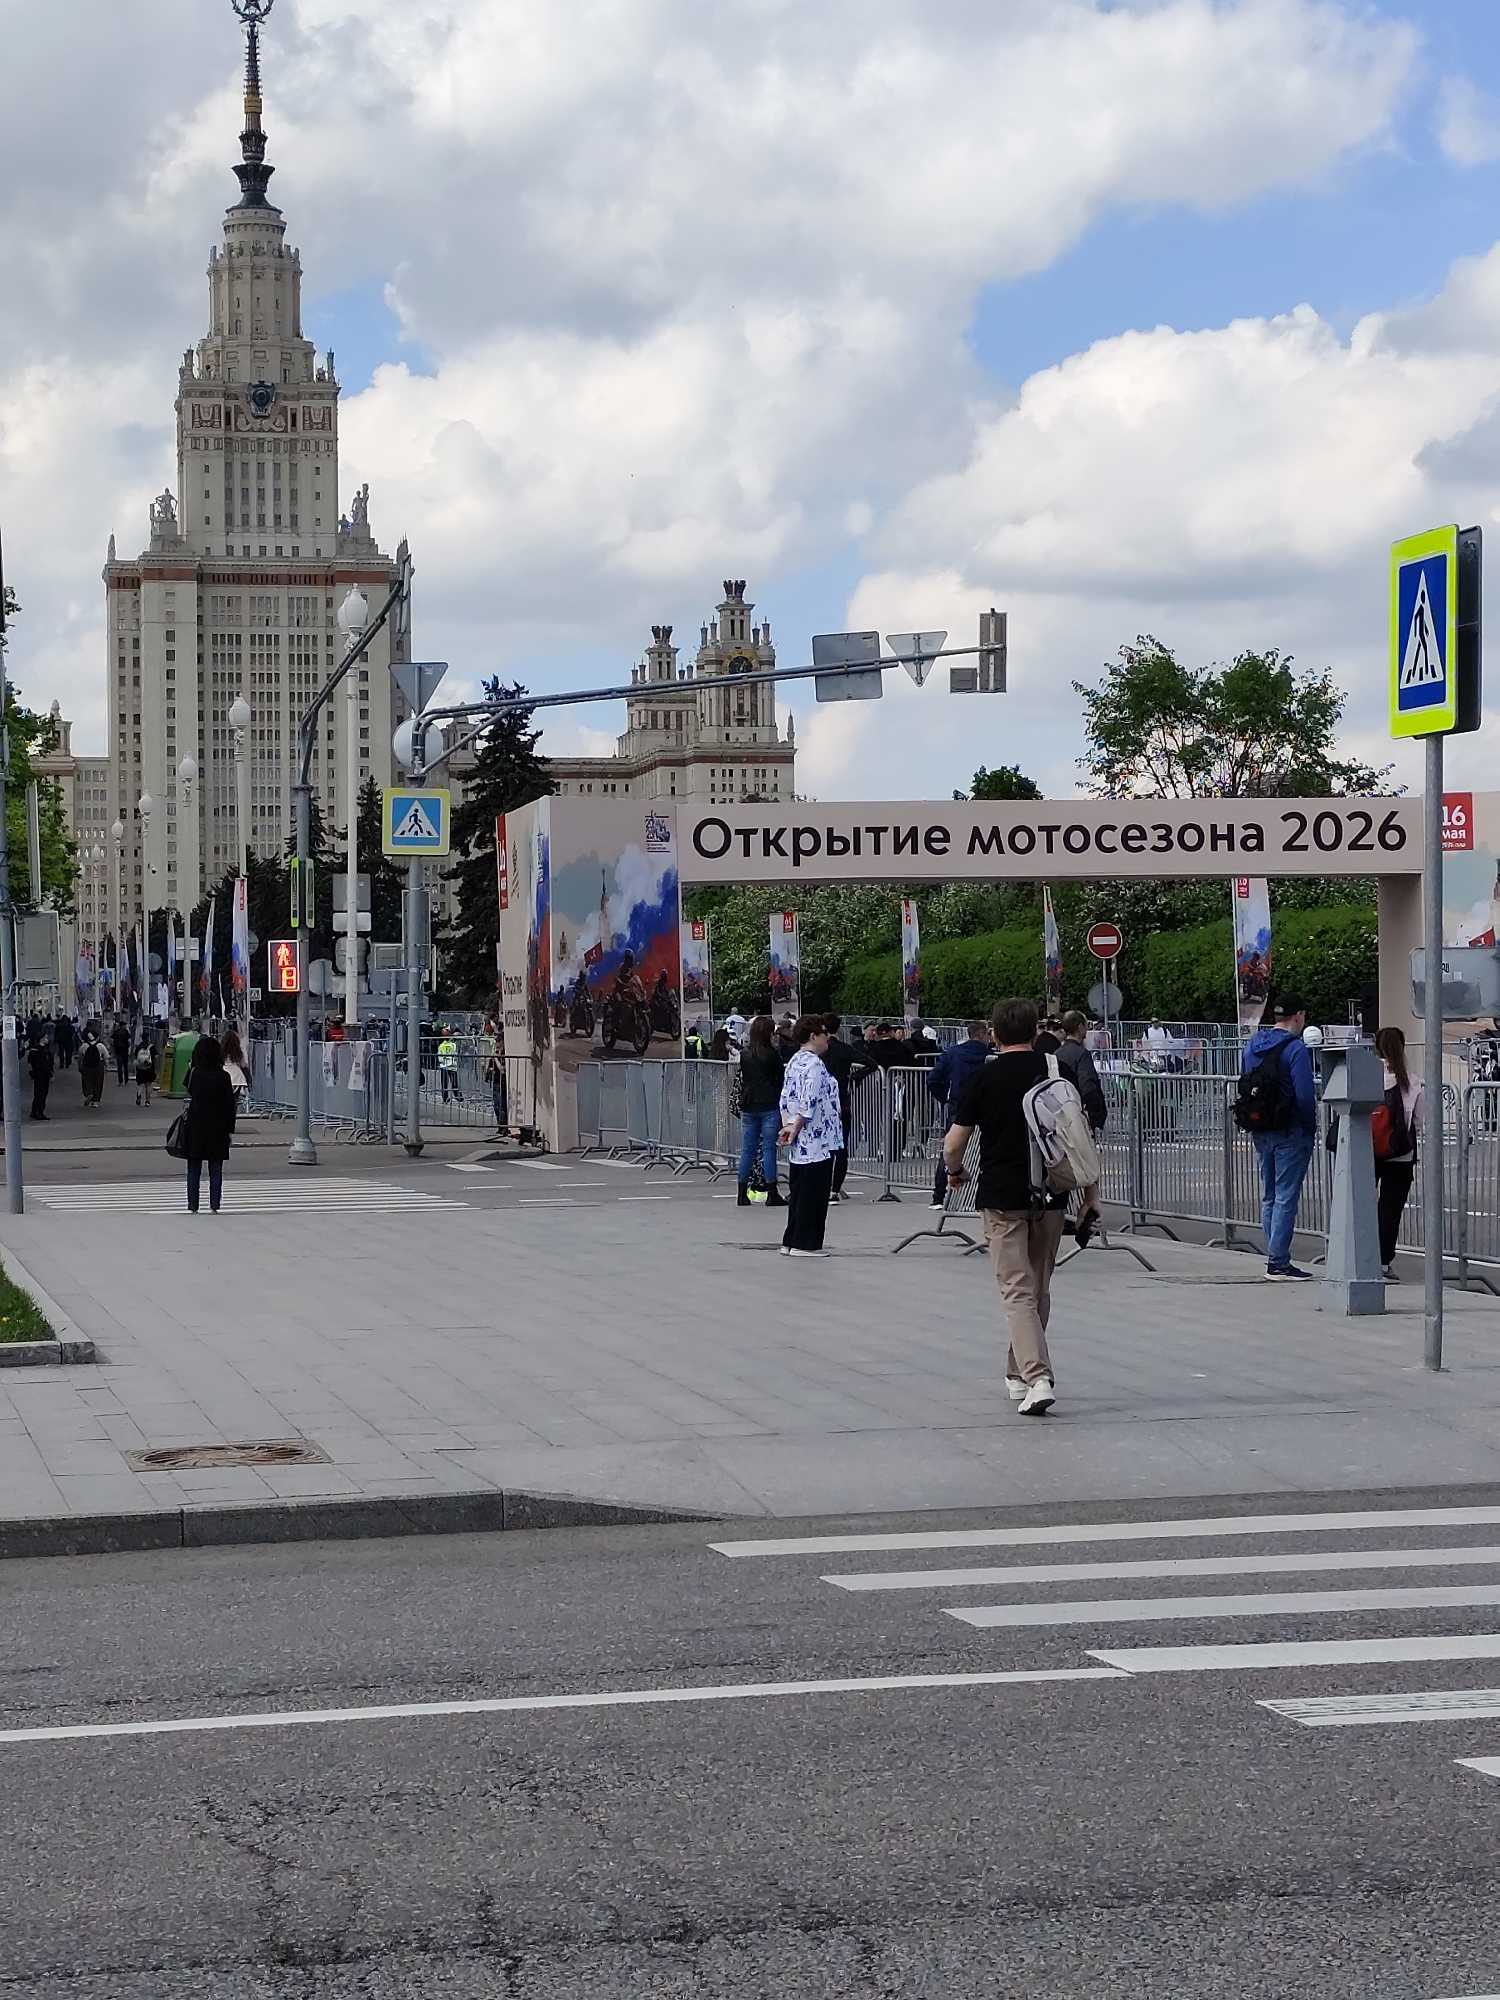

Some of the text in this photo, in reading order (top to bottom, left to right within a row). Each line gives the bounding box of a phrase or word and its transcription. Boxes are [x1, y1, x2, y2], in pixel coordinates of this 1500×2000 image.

[1442, 805, 1466, 826] 16
[692, 817, 951, 868] Открытие
[966, 822, 1265, 856] мотосезона
[1280, 810, 1407, 852] 2026
[1442, 829, 1466, 840] мая
